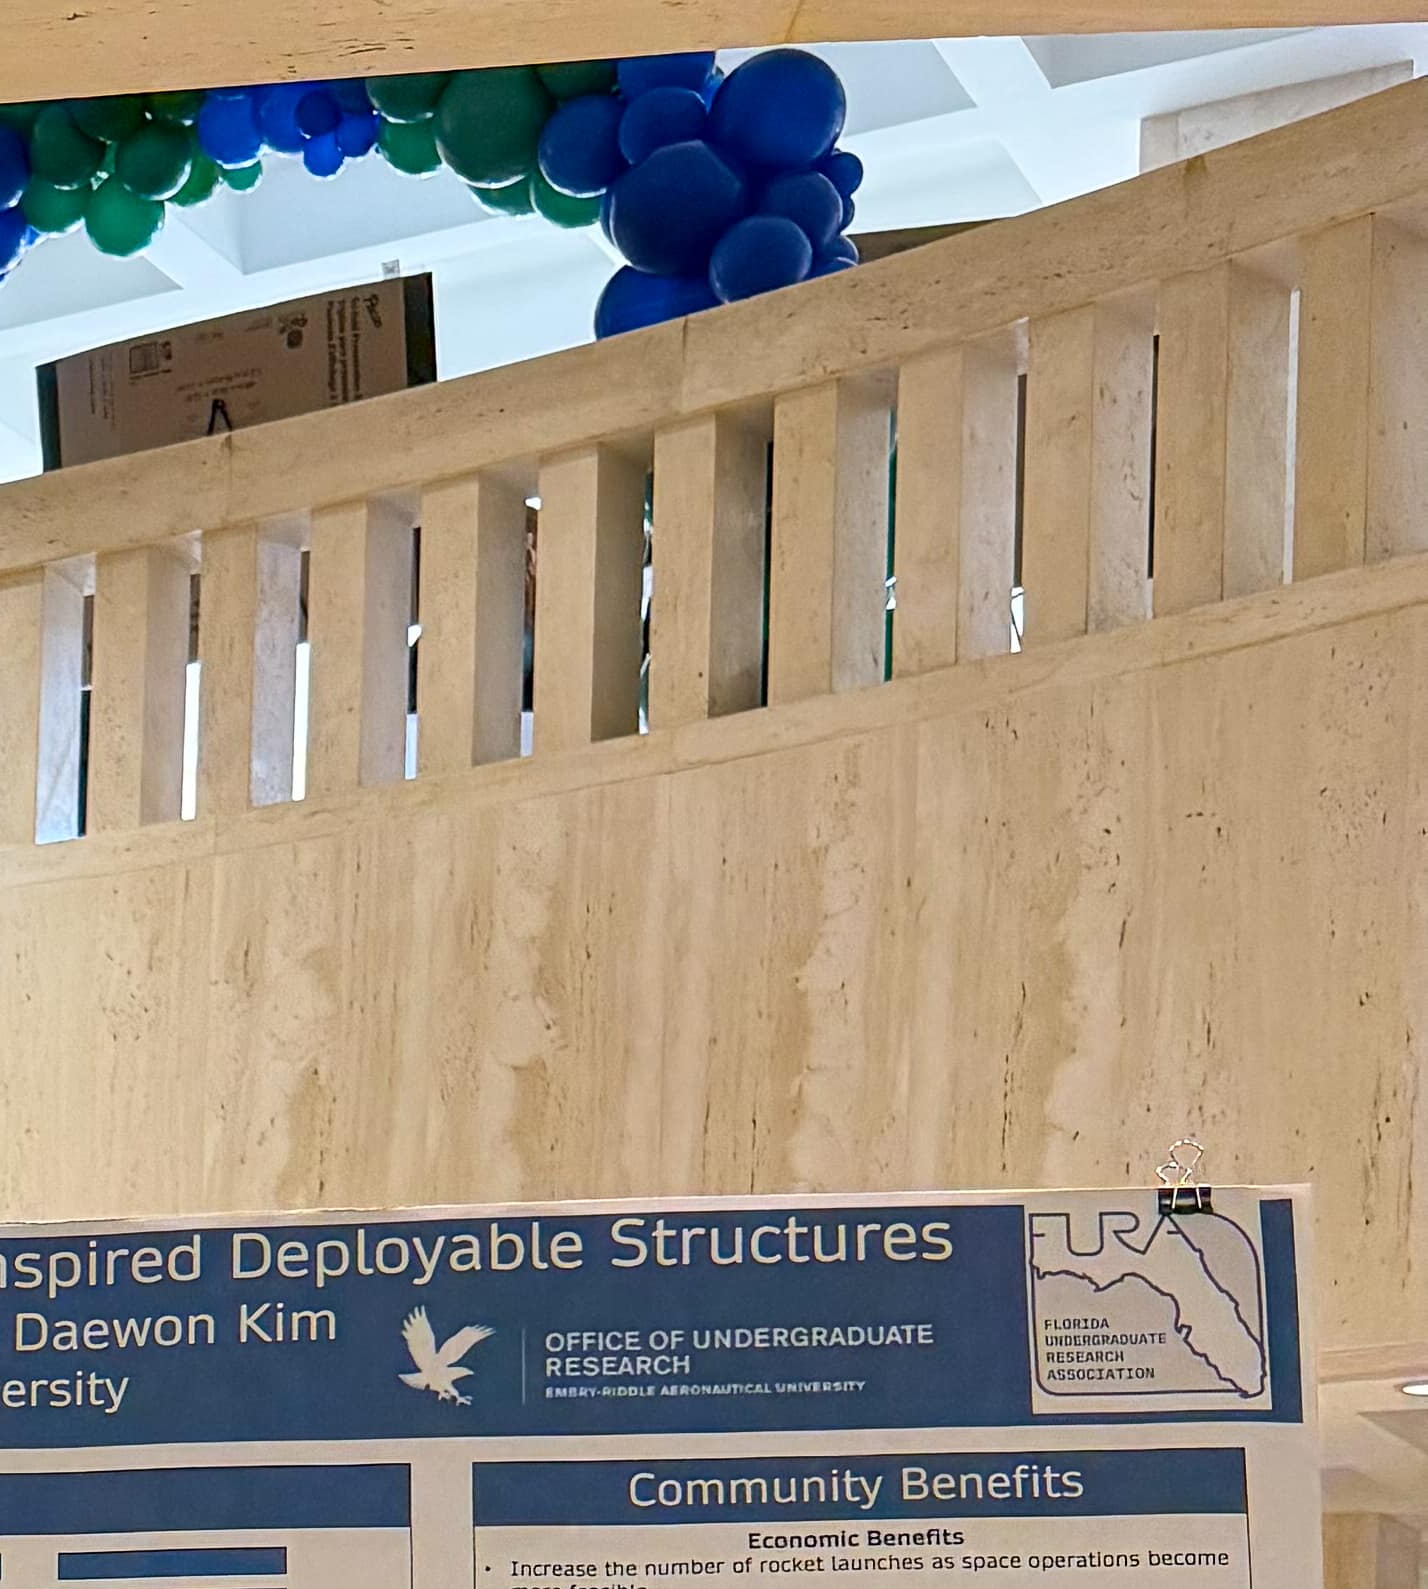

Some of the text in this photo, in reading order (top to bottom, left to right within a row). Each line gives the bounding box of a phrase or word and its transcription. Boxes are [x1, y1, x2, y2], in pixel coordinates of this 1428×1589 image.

[232, 1220, 585, 1286] Deployable
[611, 1216, 953, 1267] Structures
[15, 1312, 215, 1351] Daewon
[239, 1302, 336, 1343] Kim
[1044, 1318, 1110, 1331] FLORIDA
[545, 1324, 934, 1352] OFFICE OF UNDERGRADUATE
[1045, 1332, 1167, 1347] UNDERGRADUATE
[546, 1355, 690, 1377] RESEARCH
[1046, 1351, 1125, 1363] RESEARCH
[1047, 1367, 1156, 1381] ASSOCIATION
[545, 1380, 866, 1399] EMBRY-RIDDLE AERONAUTICAL UNIVERSITY
[629, 1464, 1084, 1510] Community Benefits
[748, 1528, 965, 1549] Economic Benefits
